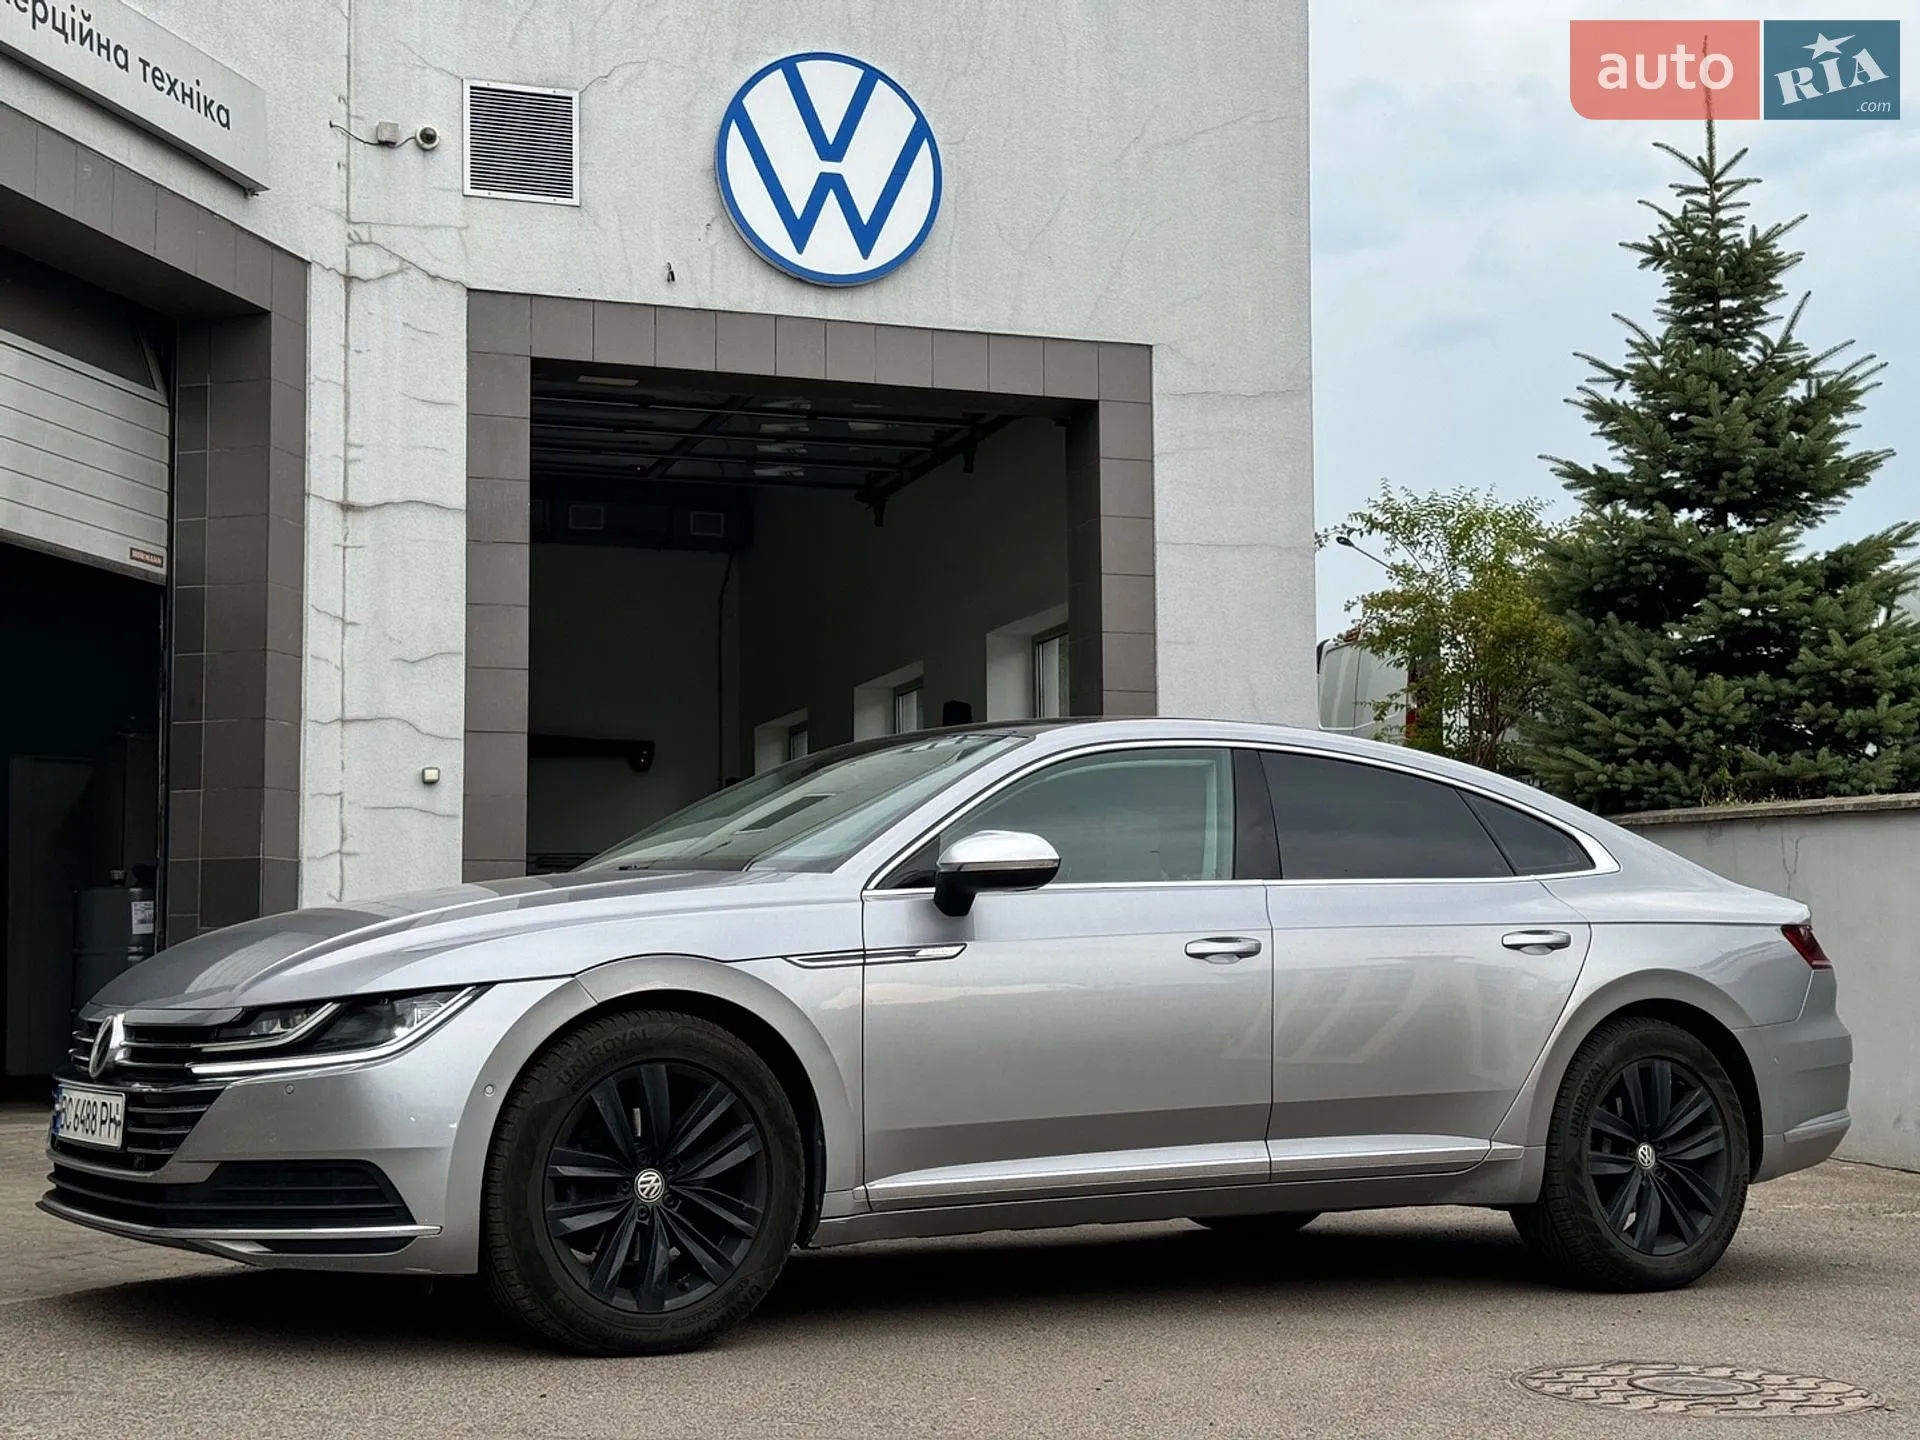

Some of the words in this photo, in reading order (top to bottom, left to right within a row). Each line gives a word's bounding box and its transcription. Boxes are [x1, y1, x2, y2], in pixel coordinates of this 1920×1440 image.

[5, 0, 130, 72] ерційна
[138, 57, 231, 130] техніка
[717, 52, 942, 284] VW
[558, 1029, 652, 1085] UNIROYAL
[74, 1098, 98, 1136] 6488
